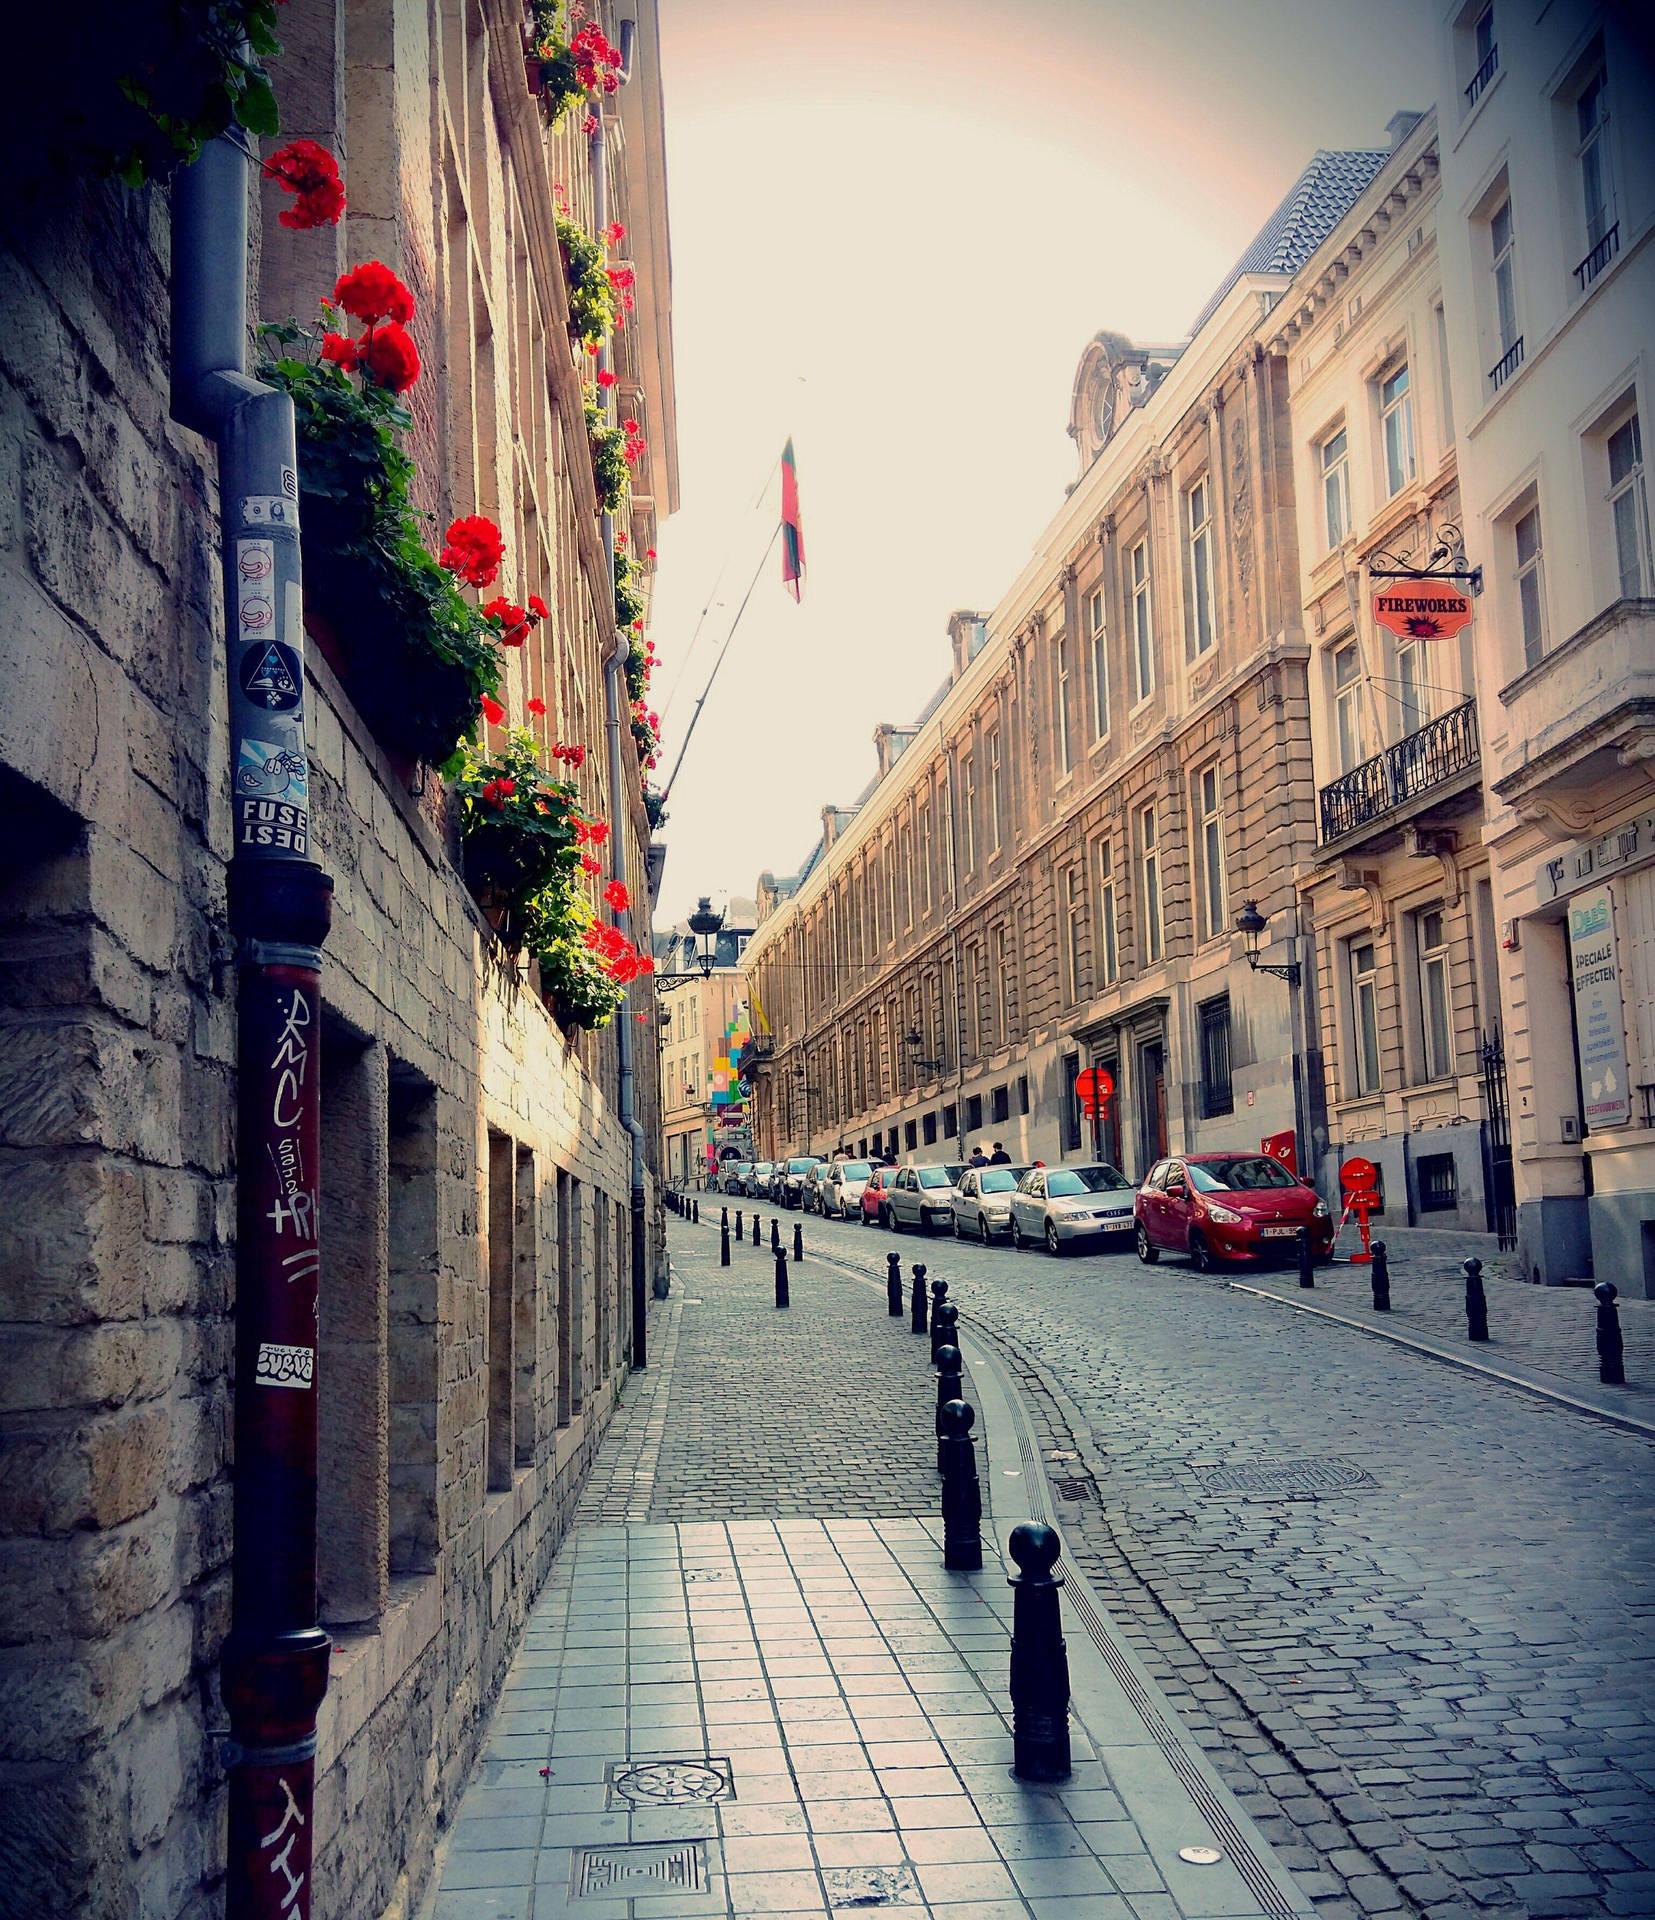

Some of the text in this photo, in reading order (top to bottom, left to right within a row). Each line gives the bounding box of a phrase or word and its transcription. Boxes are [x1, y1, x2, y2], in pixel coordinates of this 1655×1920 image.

[1378, 598, 1467, 612] FIREWORKS
[243, 800, 307, 831] FUSE
[1575, 943, 1612, 969] SPECIALE
[1576, 965, 1615, 992] EFFECTEN
